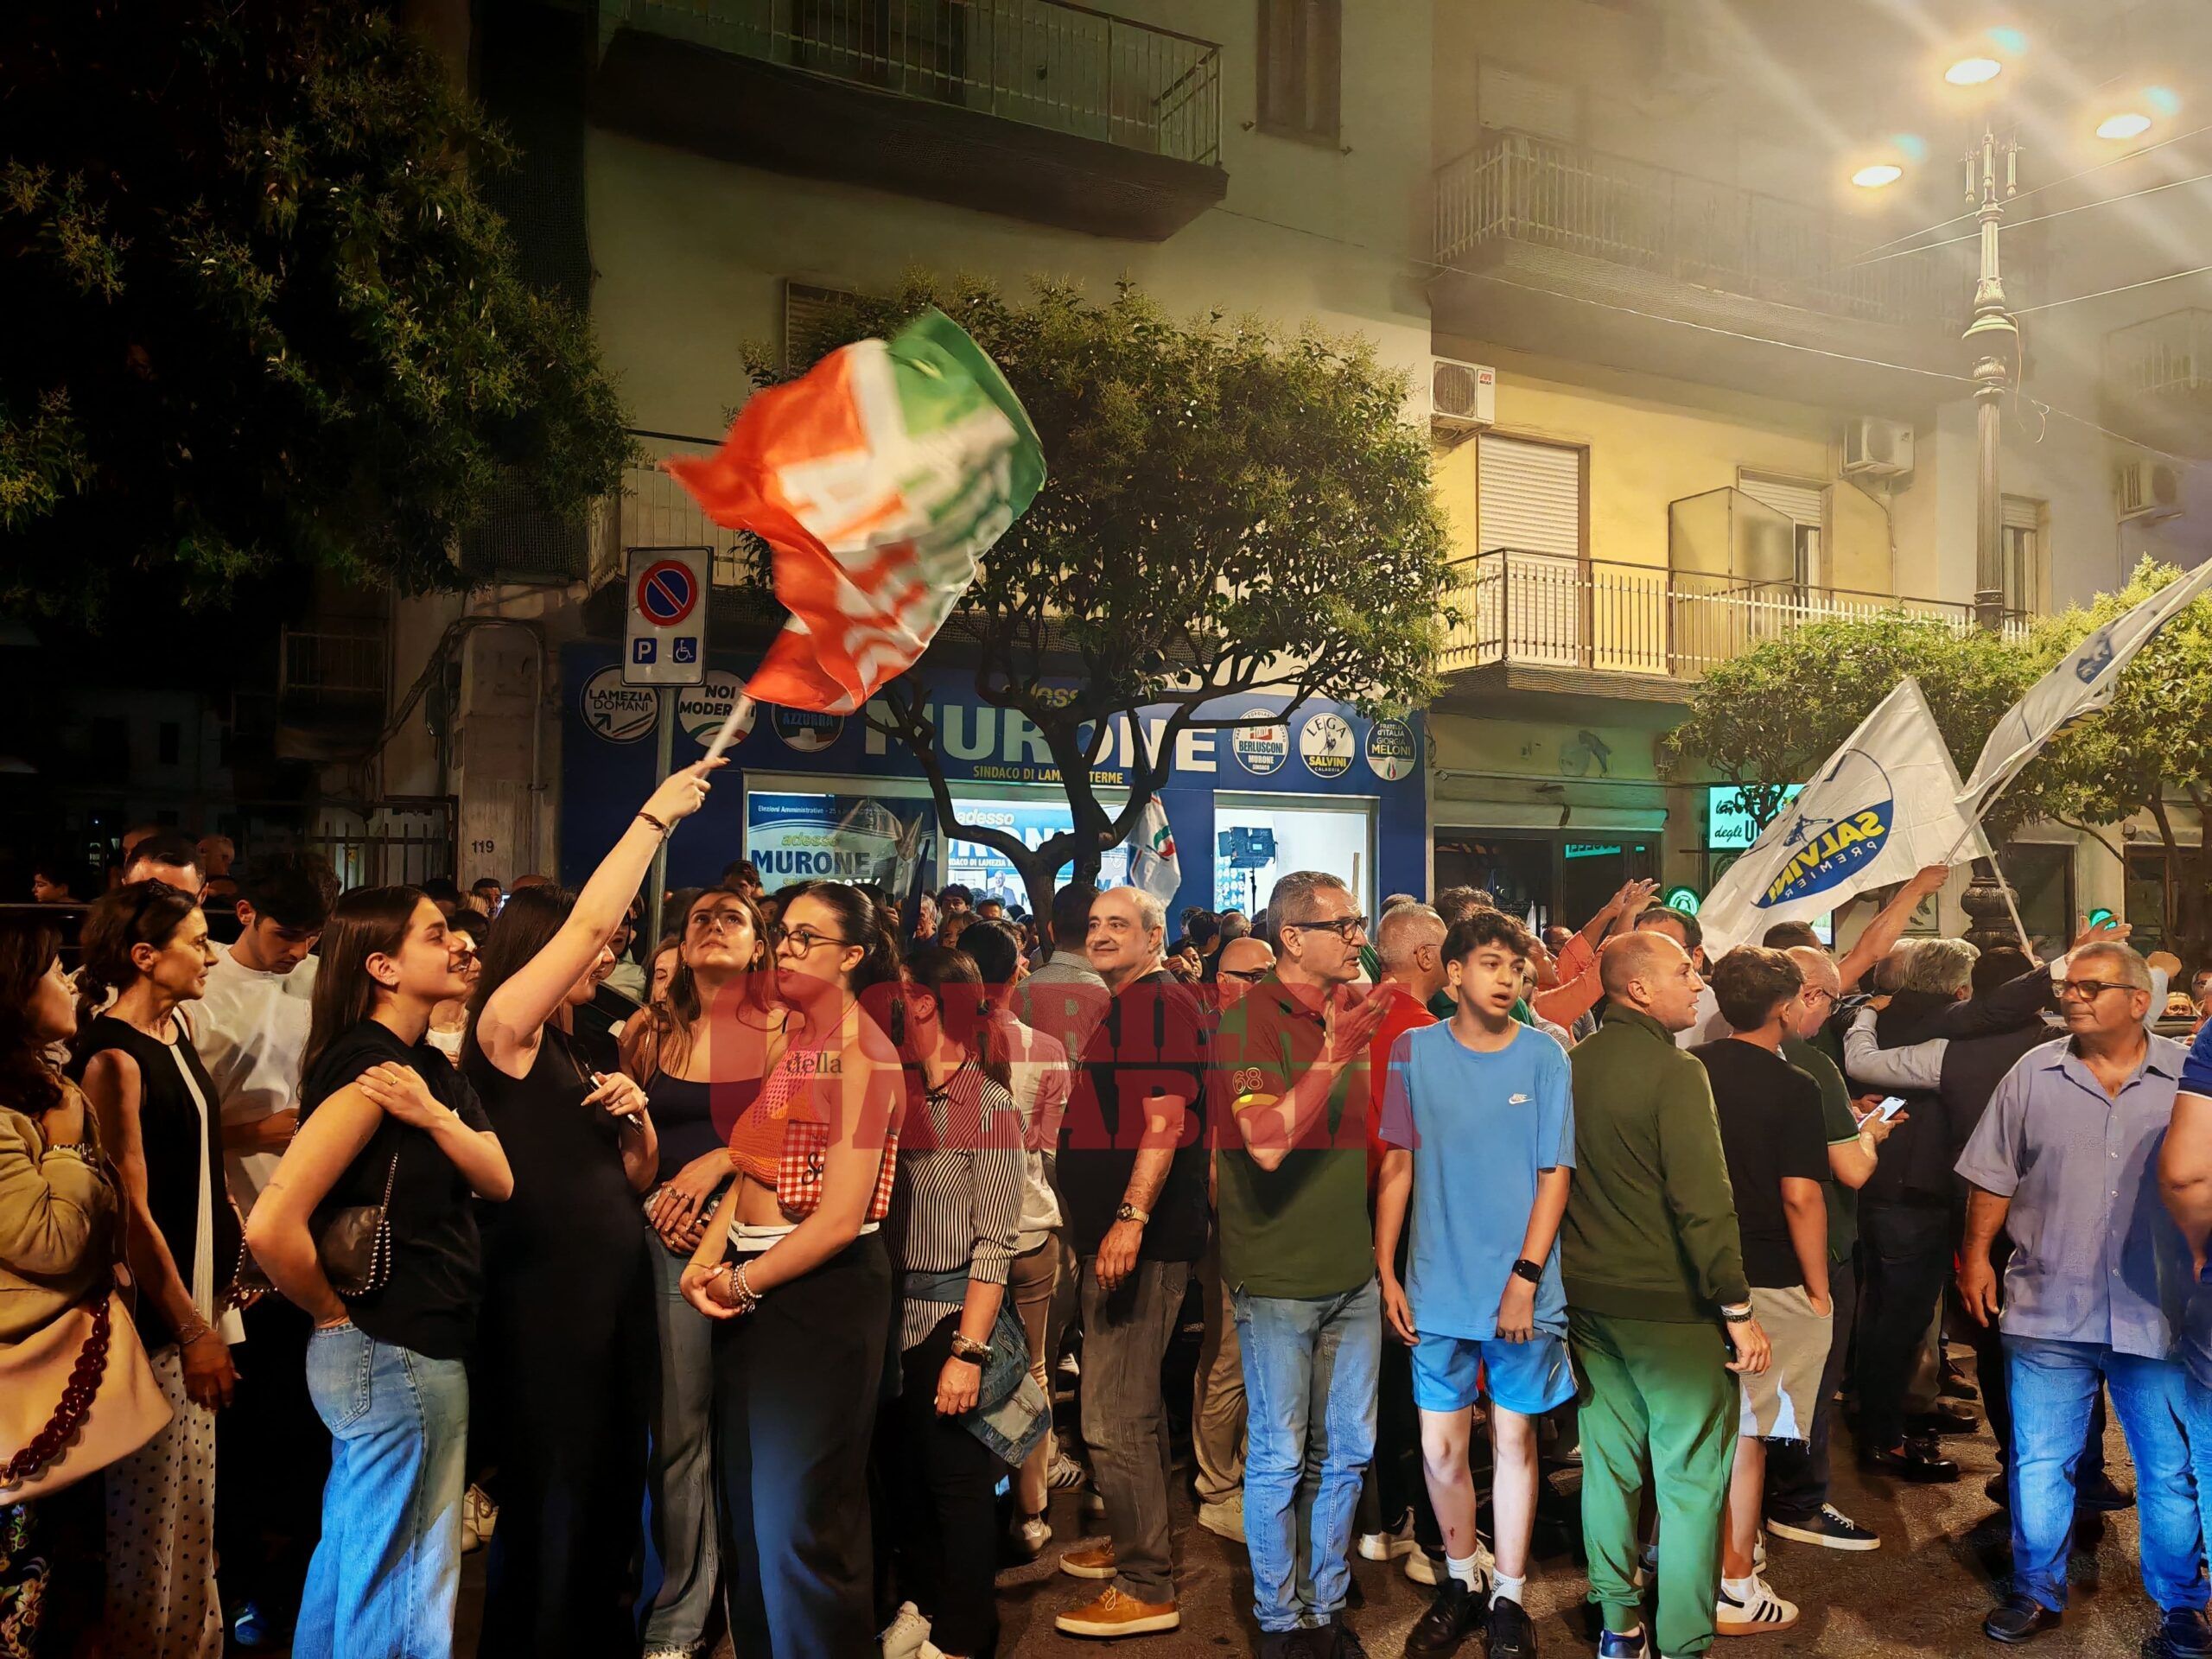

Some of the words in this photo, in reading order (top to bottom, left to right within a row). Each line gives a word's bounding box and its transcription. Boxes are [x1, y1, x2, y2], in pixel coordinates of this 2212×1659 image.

[638, 641, 652, 661] P
[588, 690, 653, 702] LAMEZIA
[704, 684, 736, 699] NOI
[594, 699, 648, 712] DOMANI
[679, 701, 755, 717] MODERI
[1306, 716, 1348, 739] LEGA
[1239, 741, 1283, 753] BERLUSCONI
[1376, 736, 1406, 746] GIORGIA
[1371, 744, 1411, 756] MELONI
[1248, 755, 1274, 764] MURONE
[1308, 756, 1347, 767] SALVINI
[973, 766, 1020, 780] SINDACO
[1023, 768, 1034, 780] DI
[1089, 771, 1123, 785] TERME
[758, 804, 780, 813] Elezioni
[781, 805, 823, 815] Amministrative
[957, 809, 1015, 825] adesso
[1714, 825, 1742, 842] degli
[472, 840, 494, 854] 119
[751, 850, 871, 875] MURONE
[978, 858, 1006, 868] LAMEZIA
[1232, 1067, 1263, 1095] 68
